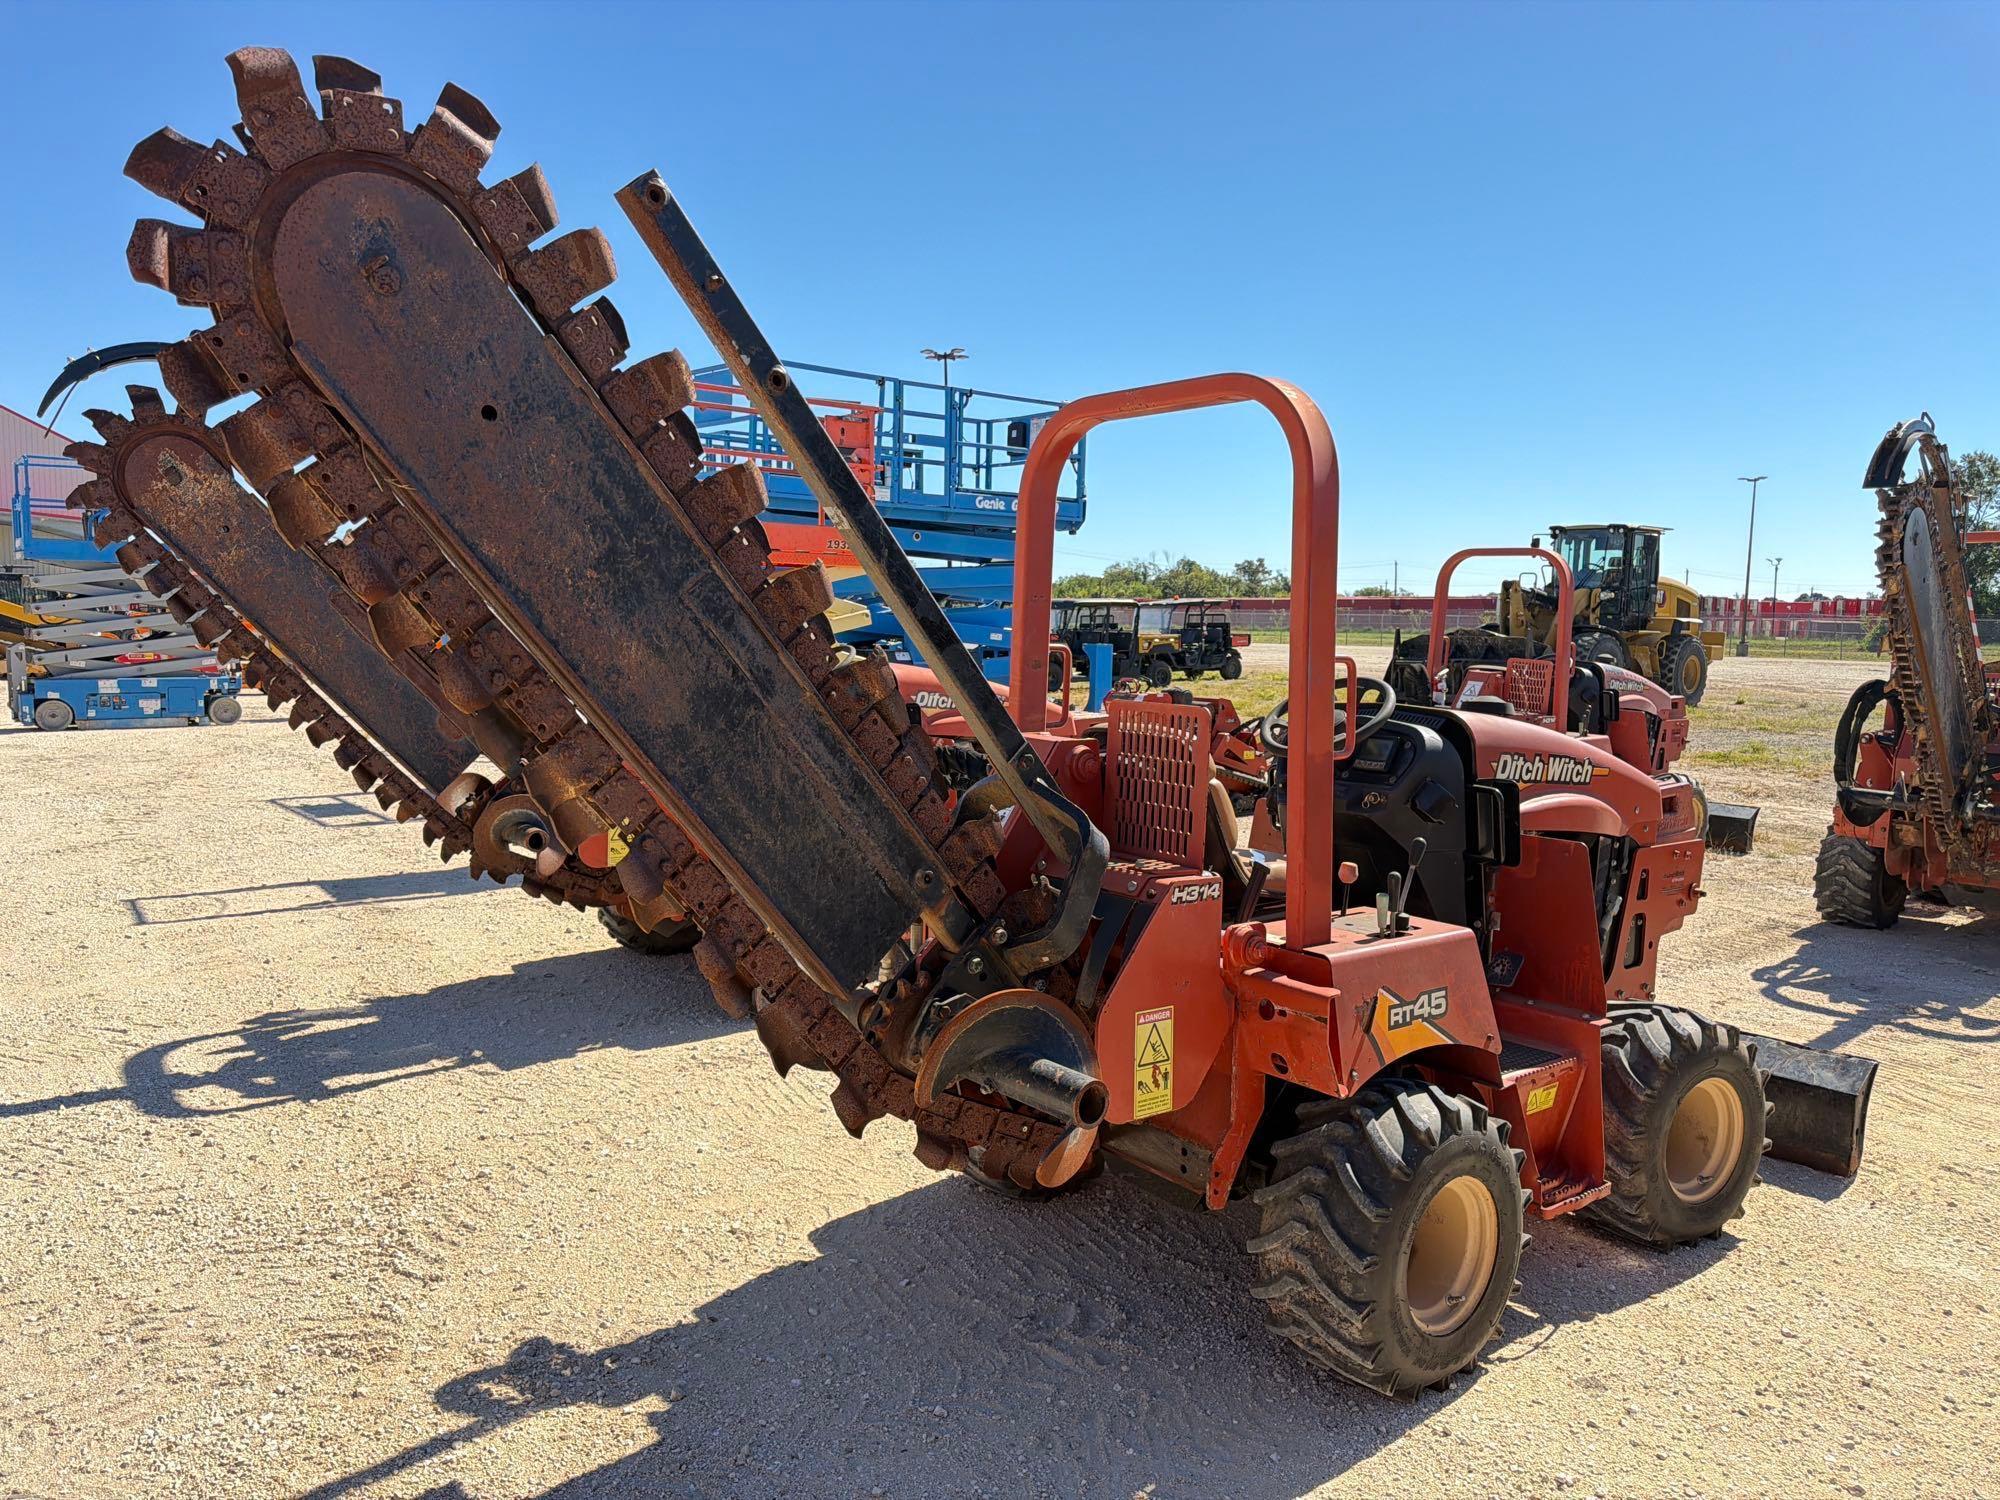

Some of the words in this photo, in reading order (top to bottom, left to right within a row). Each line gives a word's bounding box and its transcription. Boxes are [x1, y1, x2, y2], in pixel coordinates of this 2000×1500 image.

[975, 496, 1006, 510] Genie
[827, 539, 850, 550] 193
[1496, 753, 1543, 780] Ditch
[1547, 756, 1593, 783] Witch
[1171, 883, 1220, 903] H314
[1144, 1010, 1171, 1022] DANGER
[1390, 990, 1447, 1026] RT45
